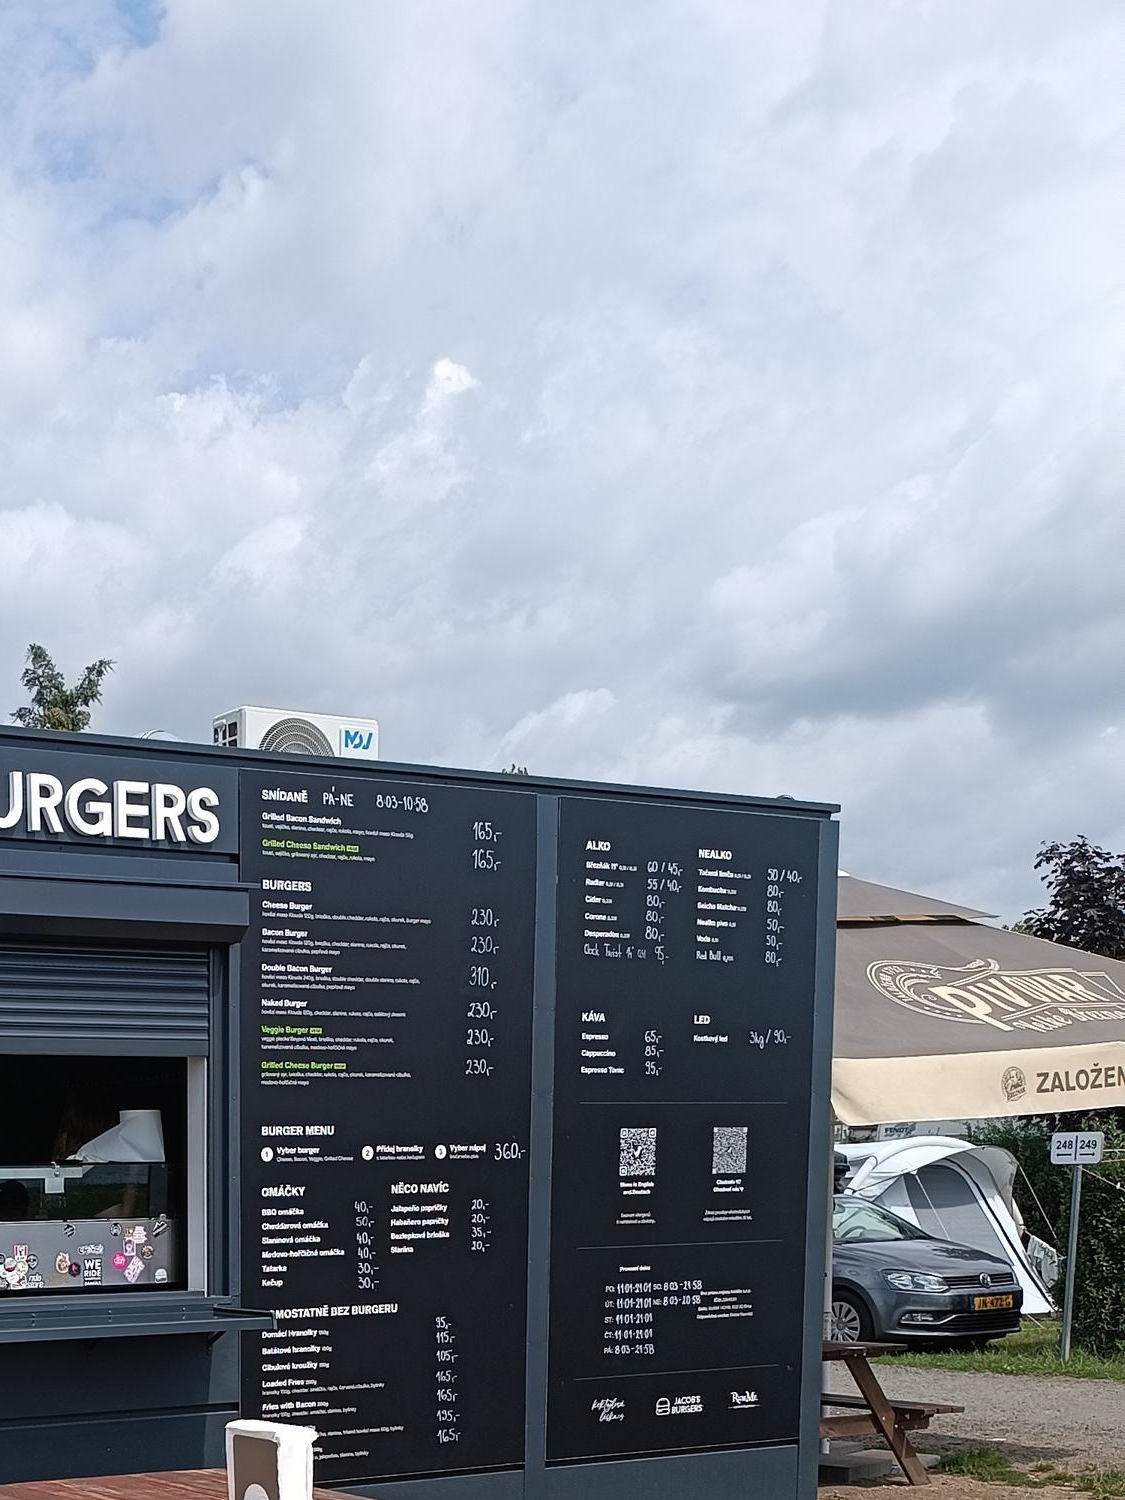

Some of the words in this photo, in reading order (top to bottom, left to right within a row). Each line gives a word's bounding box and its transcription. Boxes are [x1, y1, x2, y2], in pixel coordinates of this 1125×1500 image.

[345, 730, 373, 750] MDV
[261, 788, 308, 803] SNÍDANĚ
[262, 812, 284, 821] Grilled
[286, 814, 307, 823] Bacon
[309, 816, 341, 825] Sandwich
[262, 839, 285, 848] Grilled
[286, 840, 311, 849] Cheese
[313, 842, 345, 851] Sandwich
[585, 840, 611, 851] ALKO
[699, 849, 732, 860] NEALKO
[262, 879, 312, 892] BURGERS
[585, 895, 601, 903] Cider
[262, 901, 288, 909] Cheese
[289, 902, 312, 911] Burger
[585, 912, 606, 920] Corona
[262, 928, 284, 936] Bacon
[285, 929, 308, 938] Burger
[584, 930, 619, 938] Desperados
[709, 950, 721, 961] Bull
[261, 964, 285, 972] Double
[287, 964, 308, 973] Bacon
[309, 965, 332, 975] Burger
[261, 999, 283, 1007] Naked
[284, 1000, 307, 1008] Burger
[927, 974, 1110, 1032] PIVOVAR
[582, 1010, 605, 1022] KÁVA
[694, 1015, 711, 1024] LED
[261, 1025, 284, 1035] Veggie
[286, 1026, 308, 1034] Burger
[582, 1033, 609, 1041] Espresso
[581, 1049, 616, 1058] Cappuccino
[311, 1062, 333, 1070] Burger
[581, 1066, 608, 1074] Espresso
[261, 1126, 303, 1136] BURGER
[305, 1125, 335, 1136] MENU
[1056, 1139, 1074, 1150] 248
[1079, 1138, 1097, 1150] 249
[261, 1184, 305, 1197] OMÁČKY
[391, 1182, 418, 1194] NĚCO
[420, 1181, 450, 1193] NAVÍC
[84, 1259, 102, 1270] WE
[262, 1279, 283, 1288] Kečup
[275, 1305, 329, 1319] MOSTATNĚ
[331, 1306, 350, 1316] BEZ
[351, 1303, 398, 1315] BURGERU
[262, 1330, 287, 1339] Domácí
[288, 1329, 318, 1338] Hranolky
[262, 1346, 292, 1355] Batátové
[292, 1345, 321, 1354] hranolky
[262, 1363, 290, 1372] Cibulové
[291, 1361, 318, 1371] kroužky
[262, 1380, 287, 1388] Loaded
[287, 1378, 305, 1386] Fries
[262, 1402, 279, 1411] Fries
[280, 1401, 295, 1410] with
[295, 1400, 316, 1408] Bacon
[671, 1404, 704, 1414] BURGERS
